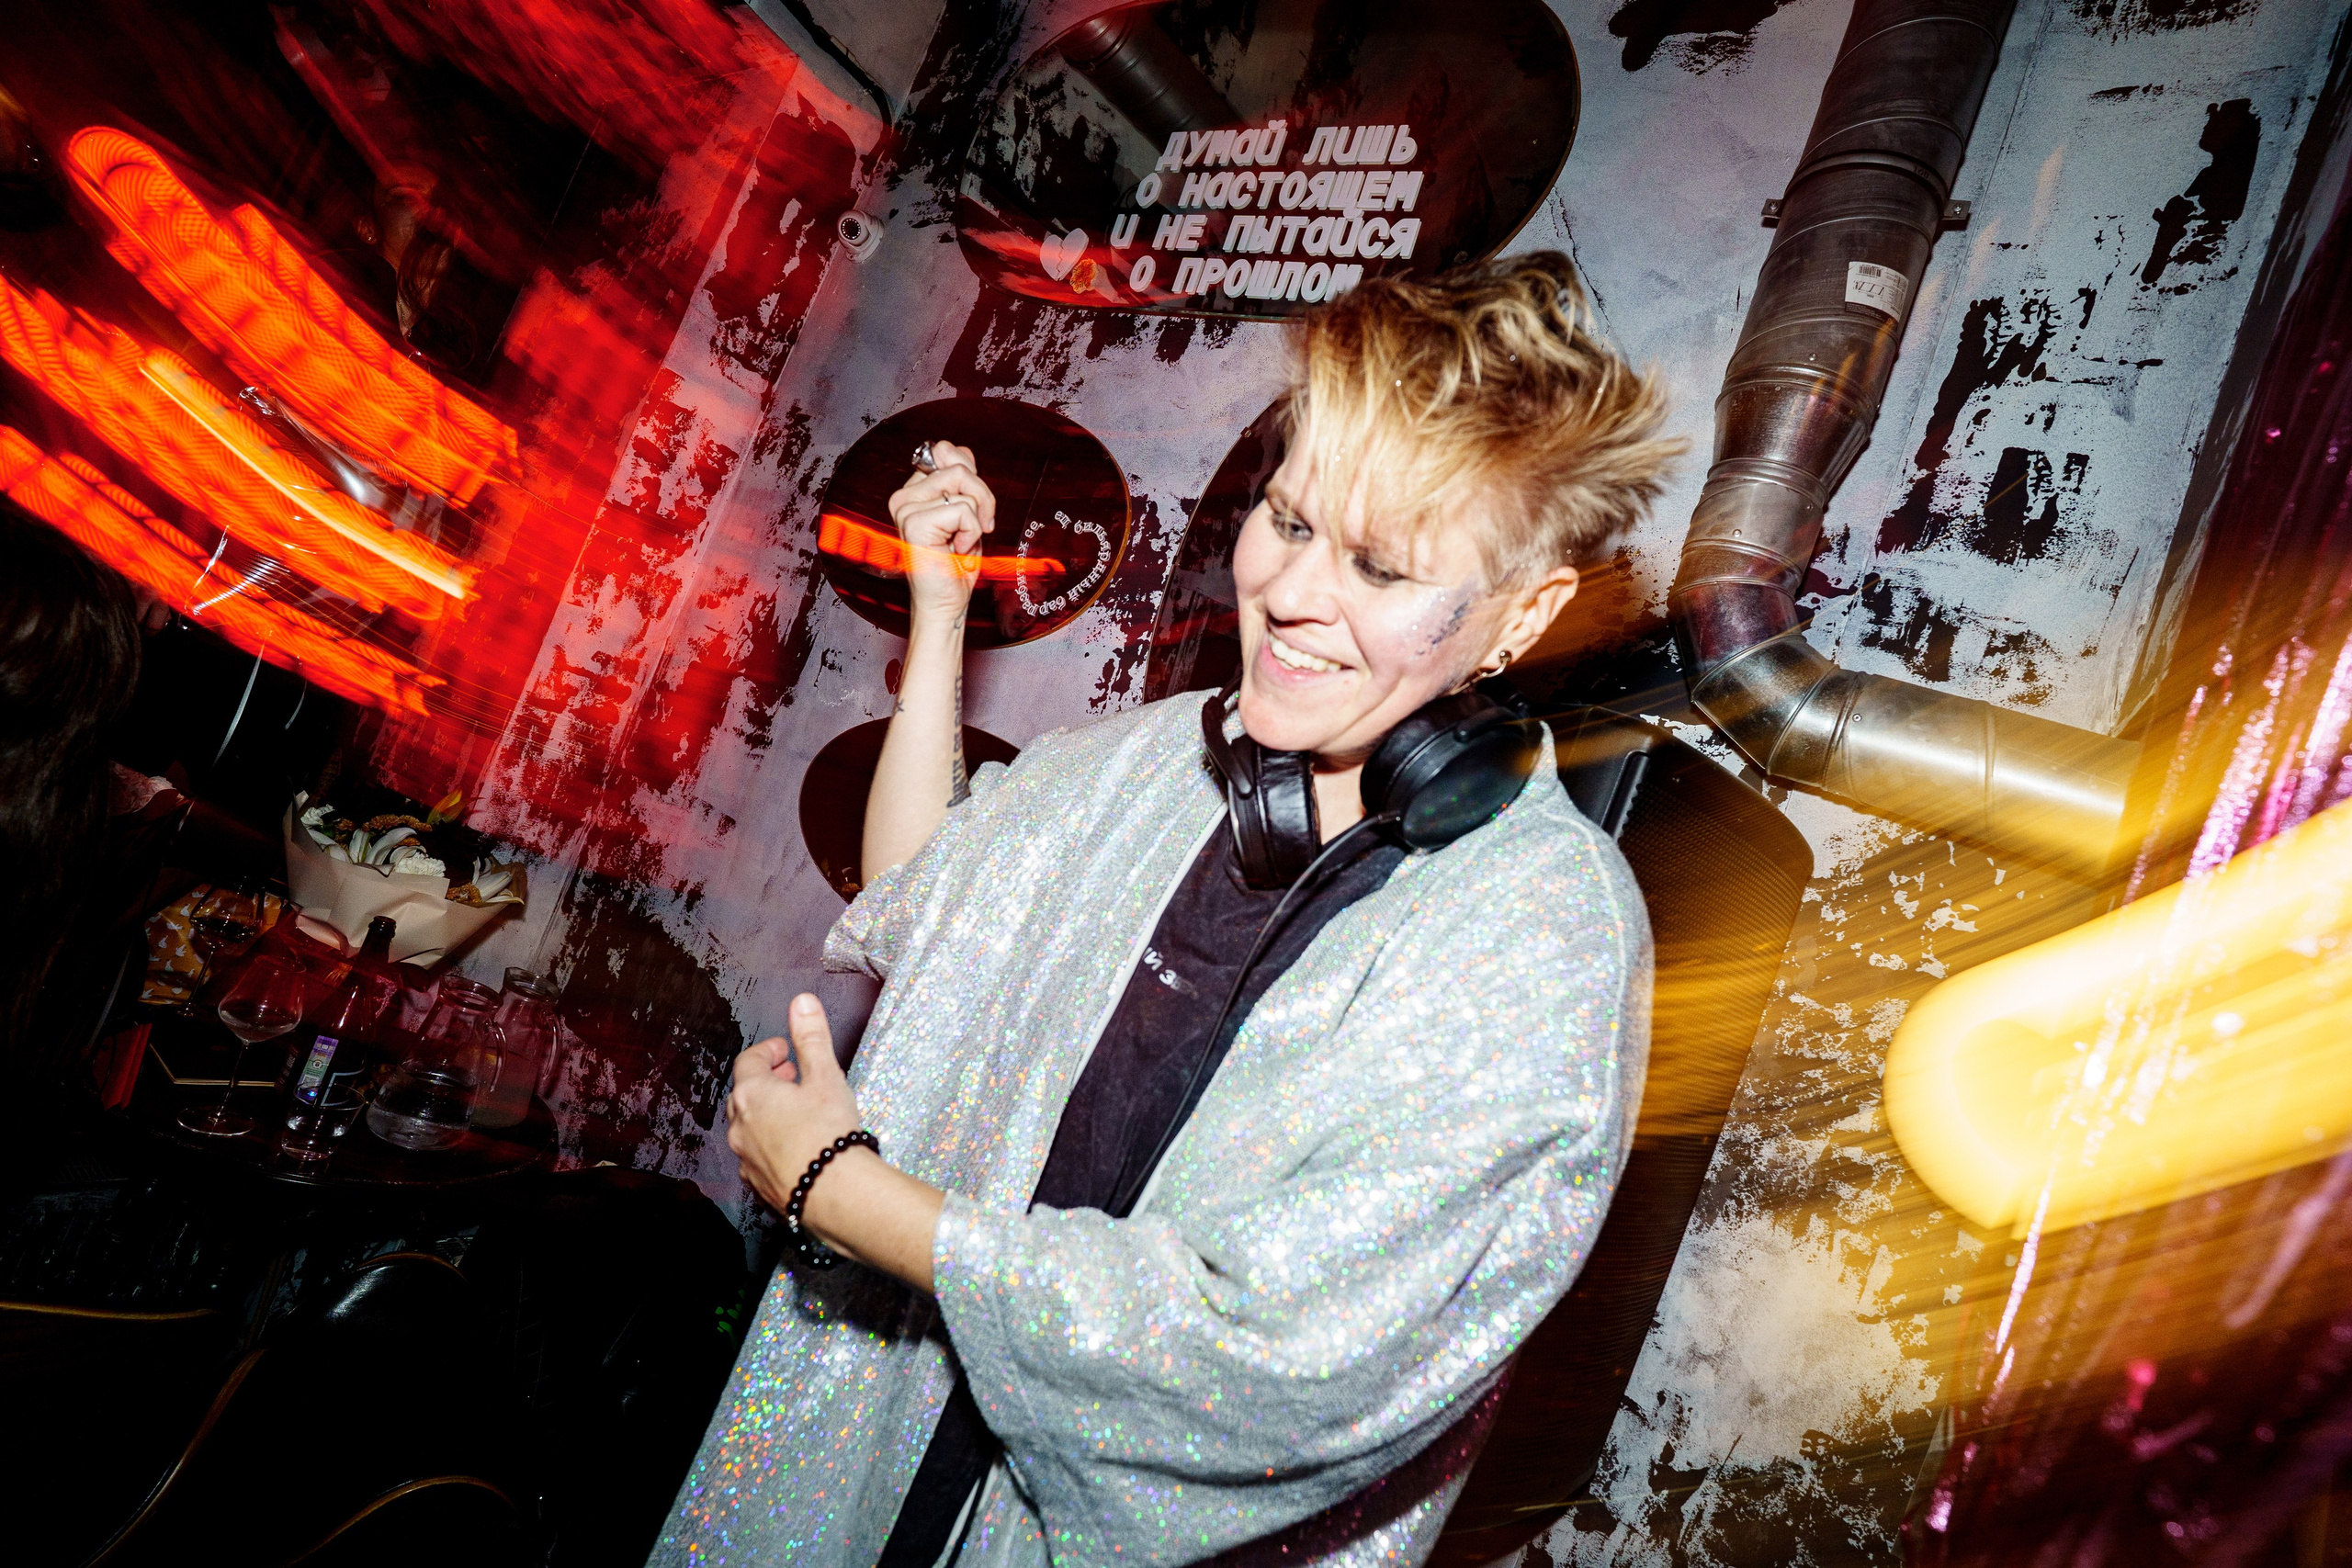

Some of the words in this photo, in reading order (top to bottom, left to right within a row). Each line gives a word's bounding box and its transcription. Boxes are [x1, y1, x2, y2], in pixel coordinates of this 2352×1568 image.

[1135, 172, 1162, 209] О
[1151, 214, 1209, 252] НЕ
[1129, 255, 1157, 293] О
[1039, 595, 1067, 616] бар
